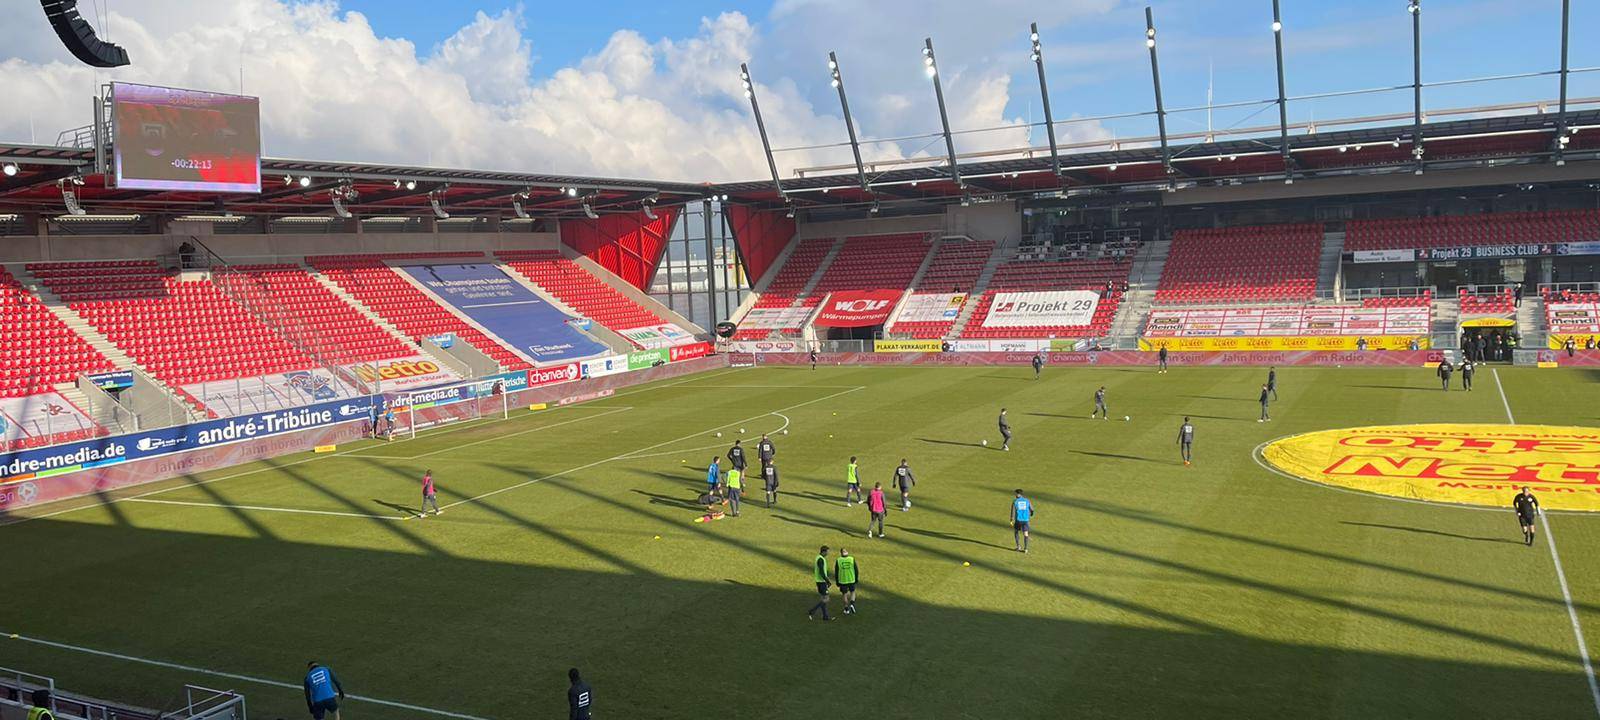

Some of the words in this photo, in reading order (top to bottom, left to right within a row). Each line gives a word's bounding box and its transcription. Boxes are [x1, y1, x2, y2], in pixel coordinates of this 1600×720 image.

[1432, 249, 1459, 259] Projekt
[1461, 247, 1471, 257] 29
[1476, 246, 1515, 257] BUSINESS
[1518, 244, 1539, 255] CLUB
[834, 299, 889, 312] WOLF
[1016, 301, 1068, 313] Projekt
[1072, 299, 1092, 311] 29
[821, 312, 888, 322] Wärmepumpen
[1330, 353, 1364, 362] Radio
[351, 360, 440, 383] Netto
[198, 407, 333, 444] andré-Tribüne
